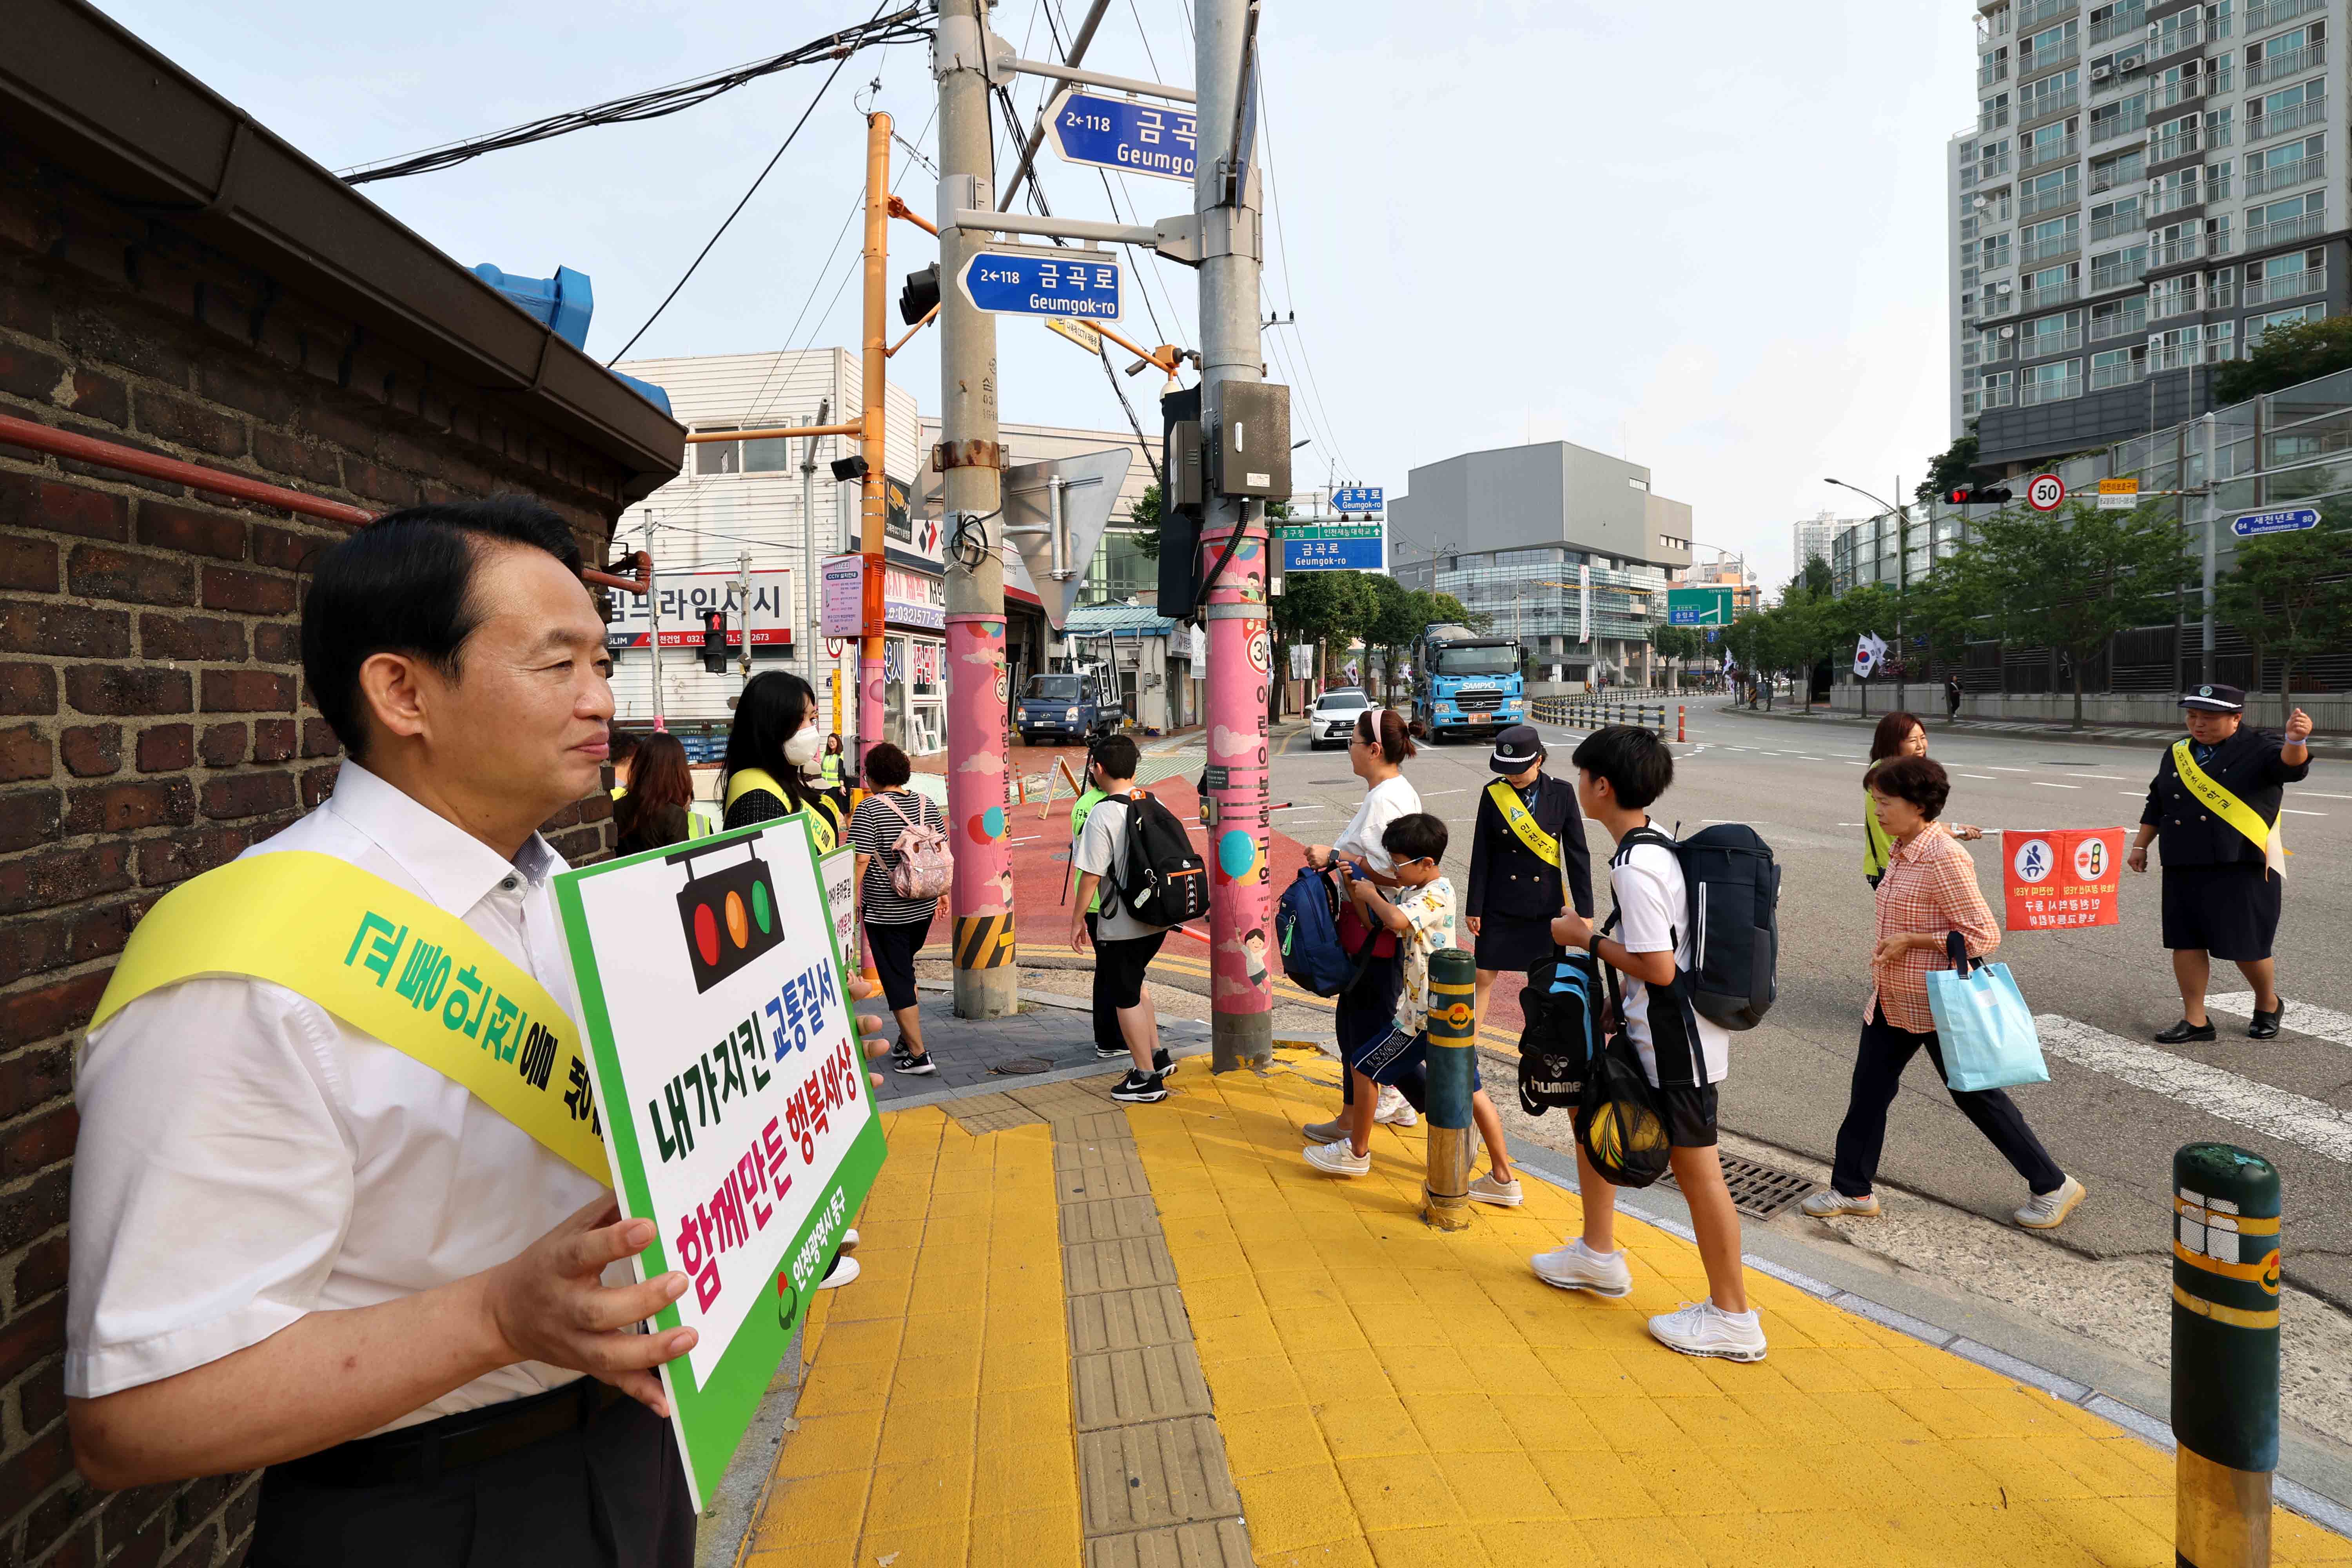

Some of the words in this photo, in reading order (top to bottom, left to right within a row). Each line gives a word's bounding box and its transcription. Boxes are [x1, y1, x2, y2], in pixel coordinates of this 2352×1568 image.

[1038, 264, 1115, 291] 금곡로
[1030, 294, 1116, 315] Geumgok-ro
[1342, 489, 1381, 501] 금곡로
[2037, 485, 2057, 500] 50
[1342, 501, 1381, 510] Geumgok-ro
[2254, 513, 2296, 524] 새천년로
[1282, 530, 1305, 538] 동구청
[1324, 528, 1371, 537] 인천재능대학교
[1302, 543, 1339, 556] 금곡로
[1296, 557, 1346, 566] Geumgok-ro
[343, 910, 559, 1092] 교통안전을
[1367, 1030, 1408, 1069] LEAGUE
[648, 1010, 771, 1161] 내가지킨
[765, 957, 837, 1063] 교통질서
[1531, 1075, 1582, 1093] humme
[677, 1115, 792, 1314] 함께만든
[785, 1037, 856, 1166] 행복세상
[792, 1207, 831, 1291] 인천광역시
[829, 1185, 847, 1230] 동구
